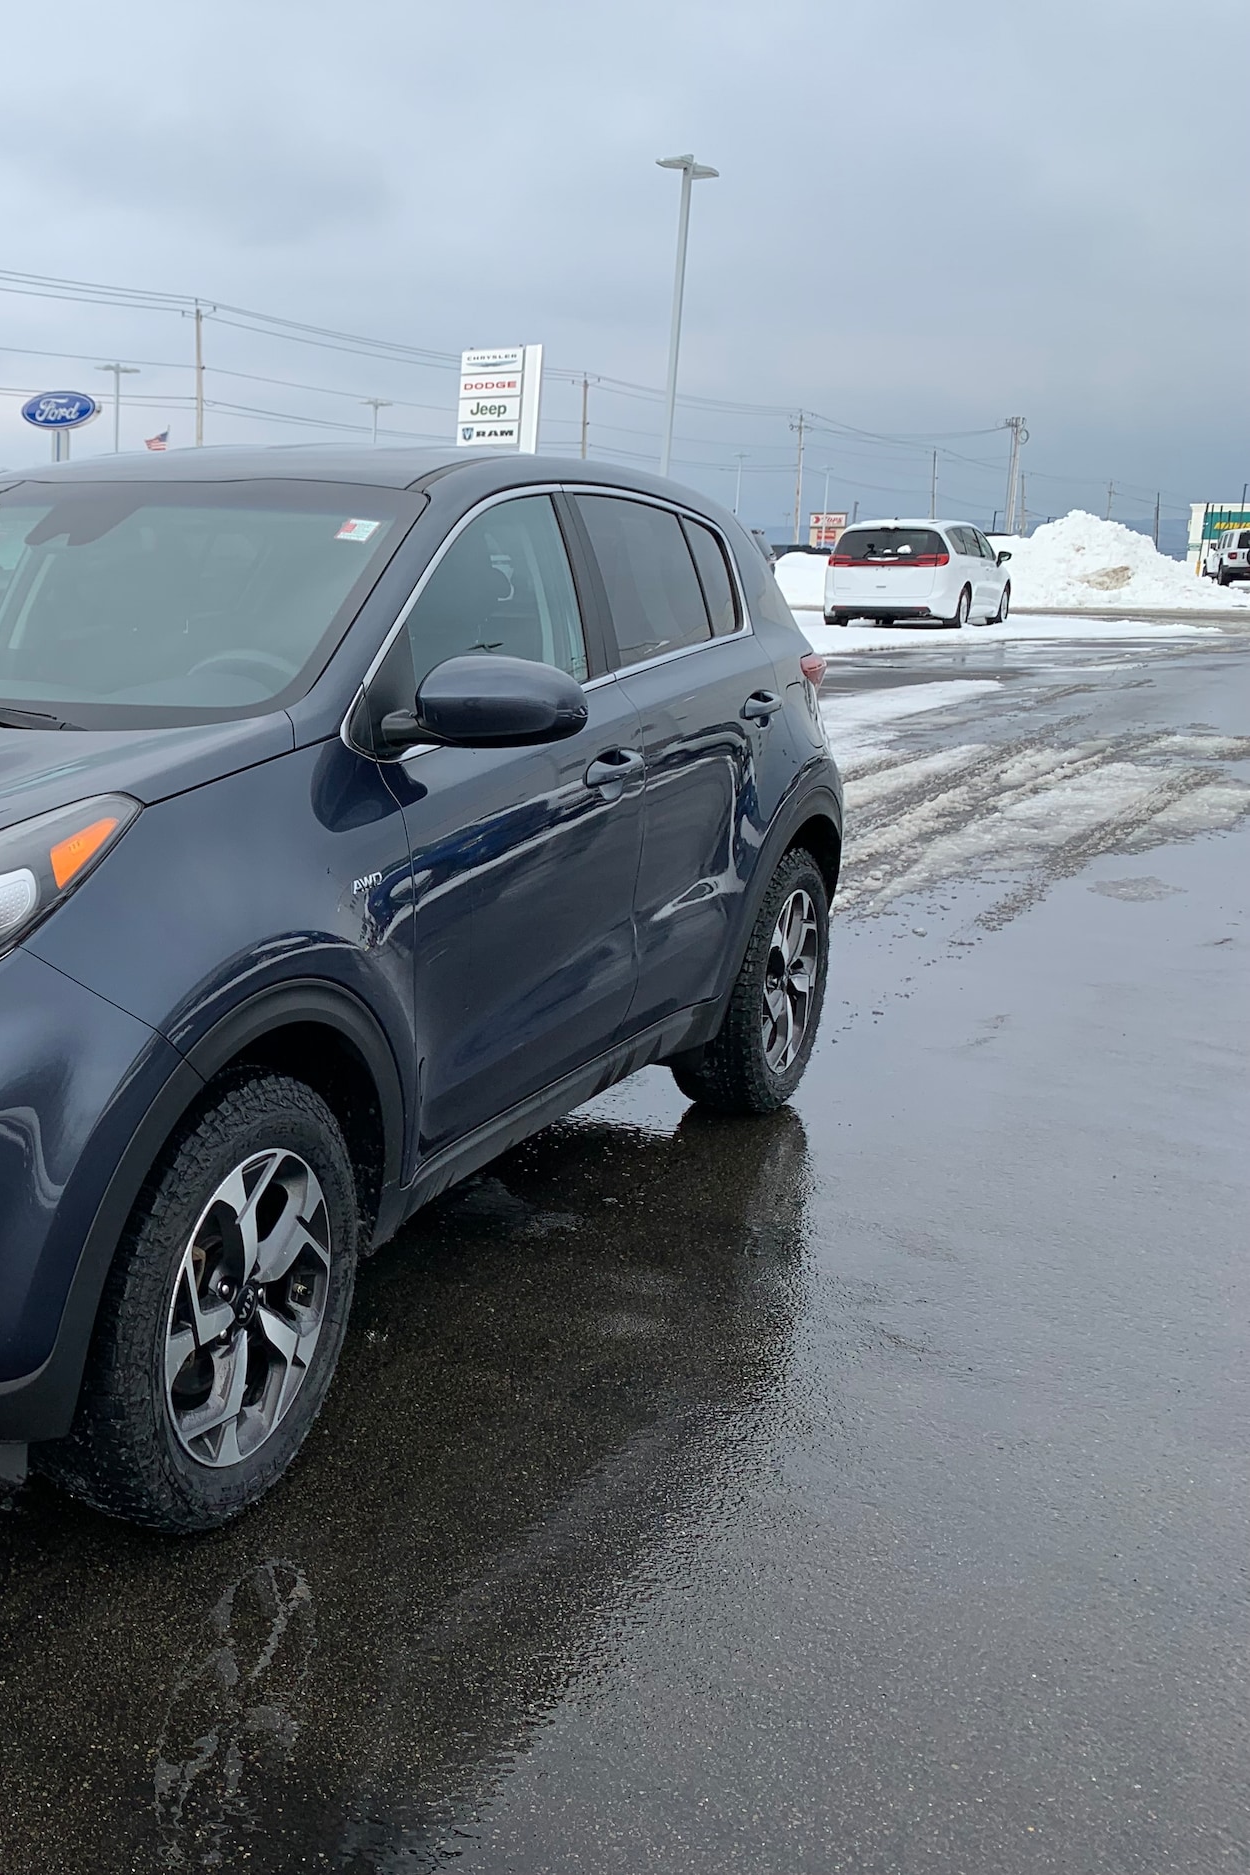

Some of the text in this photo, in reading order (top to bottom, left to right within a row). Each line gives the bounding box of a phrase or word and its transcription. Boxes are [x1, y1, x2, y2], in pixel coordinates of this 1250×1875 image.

[467, 353, 517, 361] CHRYSLER
[464, 380, 517, 390] DODGE
[35, 398, 80, 421] Ford
[470, 402, 507, 418] Jeep
[353, 871, 382, 895] AWD
[239, 1289, 254, 1318] KIA
